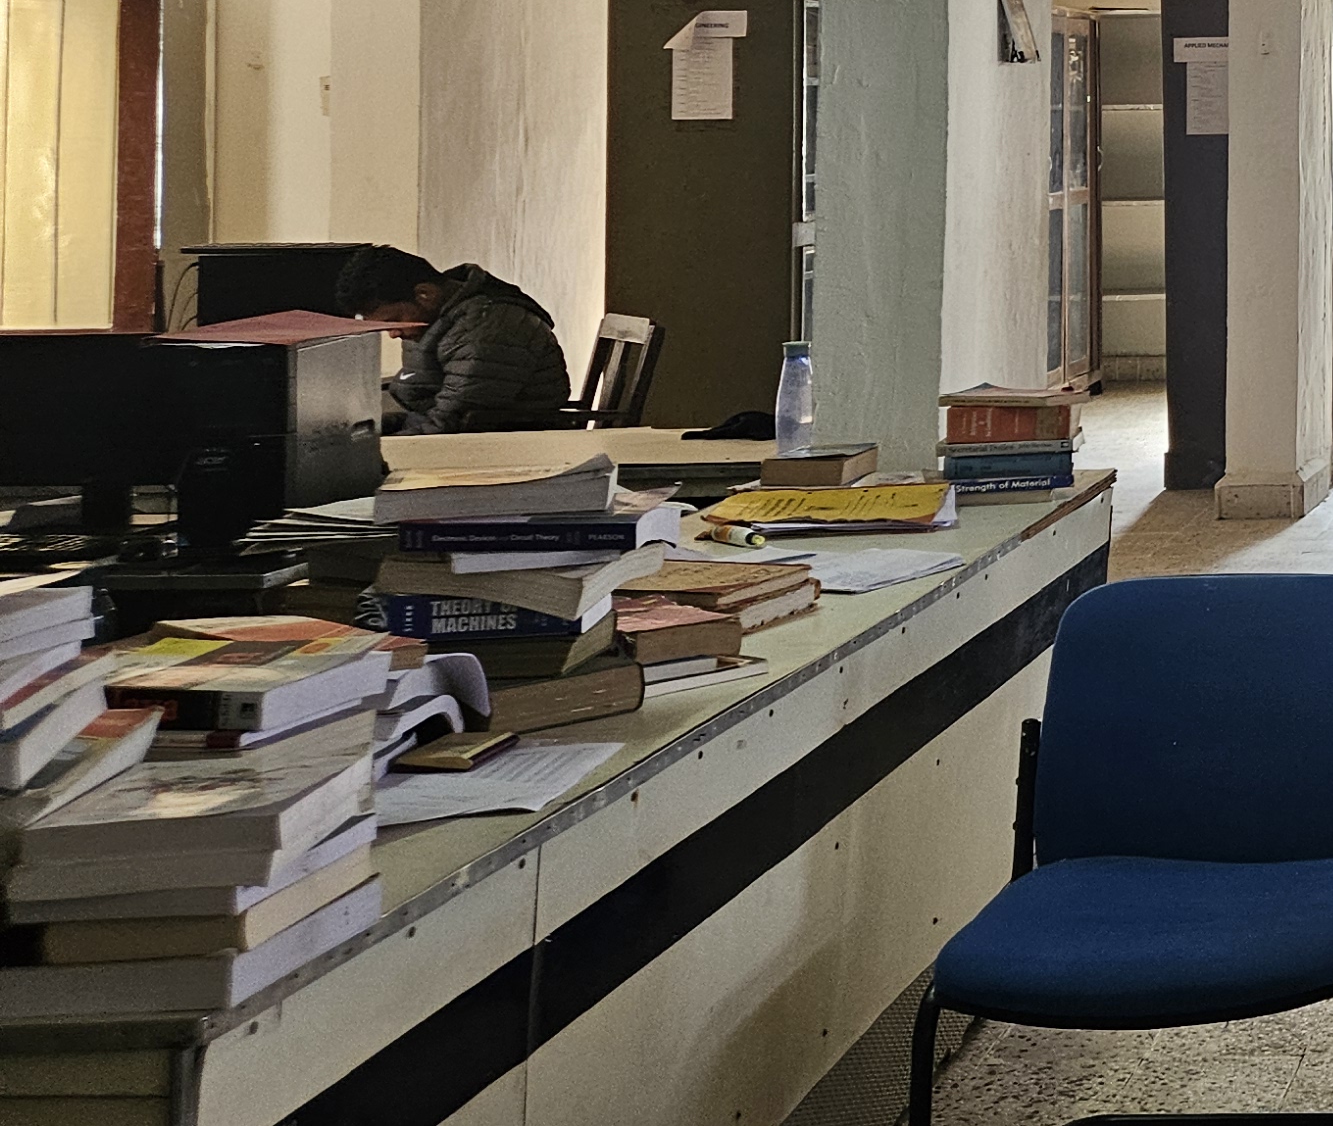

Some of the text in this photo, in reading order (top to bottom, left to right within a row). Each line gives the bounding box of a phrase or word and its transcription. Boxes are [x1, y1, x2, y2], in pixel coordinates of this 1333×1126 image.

[955, 480, 996, 493] Strength
[999, 480, 1009, 489] of
[535, 533, 560, 543] Theory
[588, 533, 626, 541] PEARSON
[430, 599, 491, 616] THEORY
[431, 614, 518, 634] MACHINES
